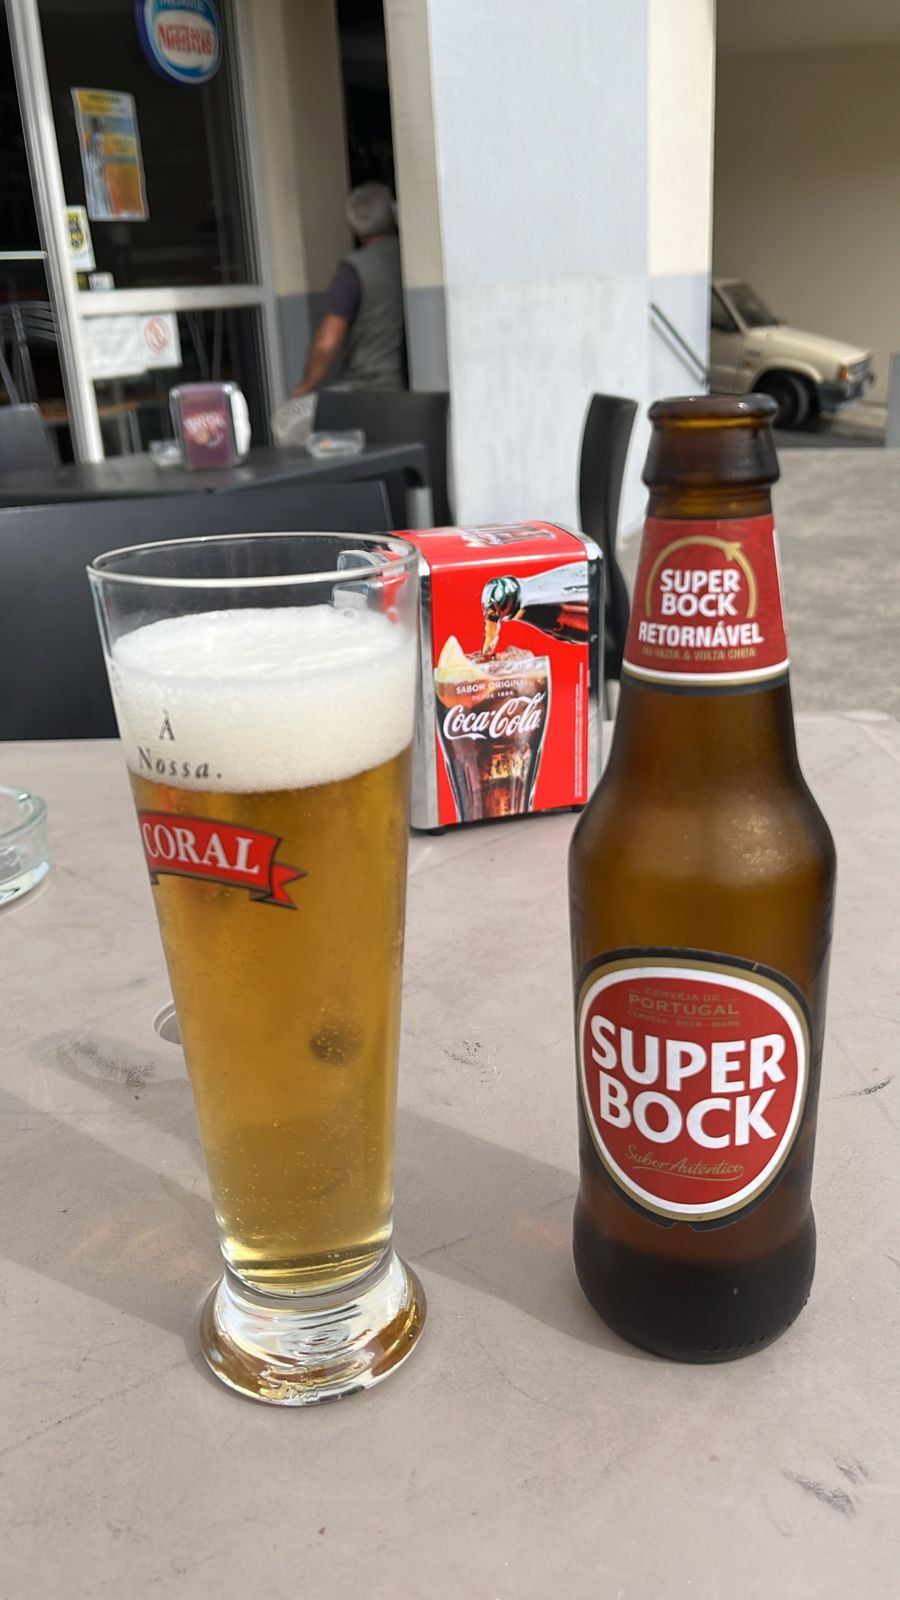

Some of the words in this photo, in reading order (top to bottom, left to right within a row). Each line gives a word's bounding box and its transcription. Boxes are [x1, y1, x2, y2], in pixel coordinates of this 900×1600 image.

[660, 569, 740, 593] SUPER
[661, 593, 738, 617] BOCK
[638, 620, 764, 648] RETORNÁVEL
[694, 649, 724, 661] VOLTA
[728, 647, 757, 660] CHEIA
[456, 682, 485, 695] SABOR
[488, 679, 529, 690] ORIGINAL
[443, 692, 546, 740] Coca-Cola
[137, 745, 222, 779] Nossa.
[142, 822, 260, 874] CORAL
[628, 993, 740, 1016] PORTUGAL
[644, 988, 698, 1001] CERVEJA
[704, 993, 720, 1002] DE
[590, 1014, 786, 1094] SUPER
[599, 1069, 777, 1149] BOCK
[624, 1144, 668, 1170] Sabor
